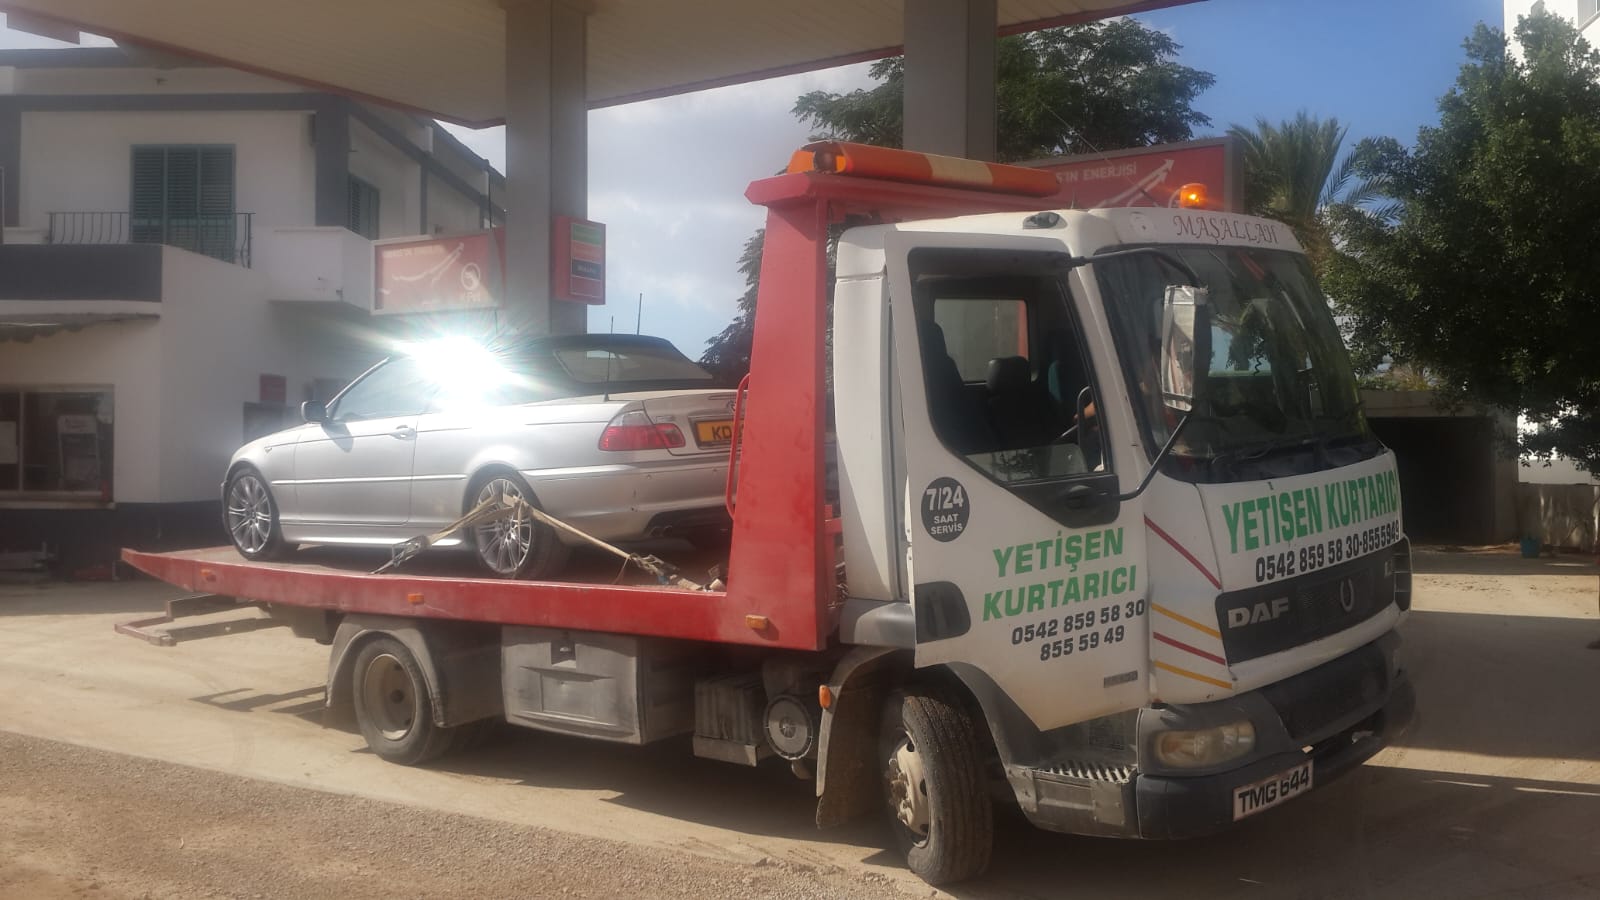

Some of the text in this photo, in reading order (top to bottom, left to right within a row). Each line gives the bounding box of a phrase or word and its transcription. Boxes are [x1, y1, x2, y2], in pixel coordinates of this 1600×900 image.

[1173, 215, 1279, 244] MAŞALLAH
[926, 485, 964, 511] 7/24
[931, 523, 963, 535] SERVİS
[934, 513, 959, 524] SAAT
[993, 527, 1124, 578] YETİŞEN
[1256, 550, 1295, 582] 0542
[1300, 543, 1324, 572] 859
[1328, 538, 1342, 566] 58
[982, 565, 1137, 622] KURTARICI
[1012, 599, 1145, 645] 0542 859 58 30
[1228, 597, 1289, 628] DAF
[1040, 625, 1125, 661] 855 59 49
[1238, 765, 1309, 812] TMG 644
